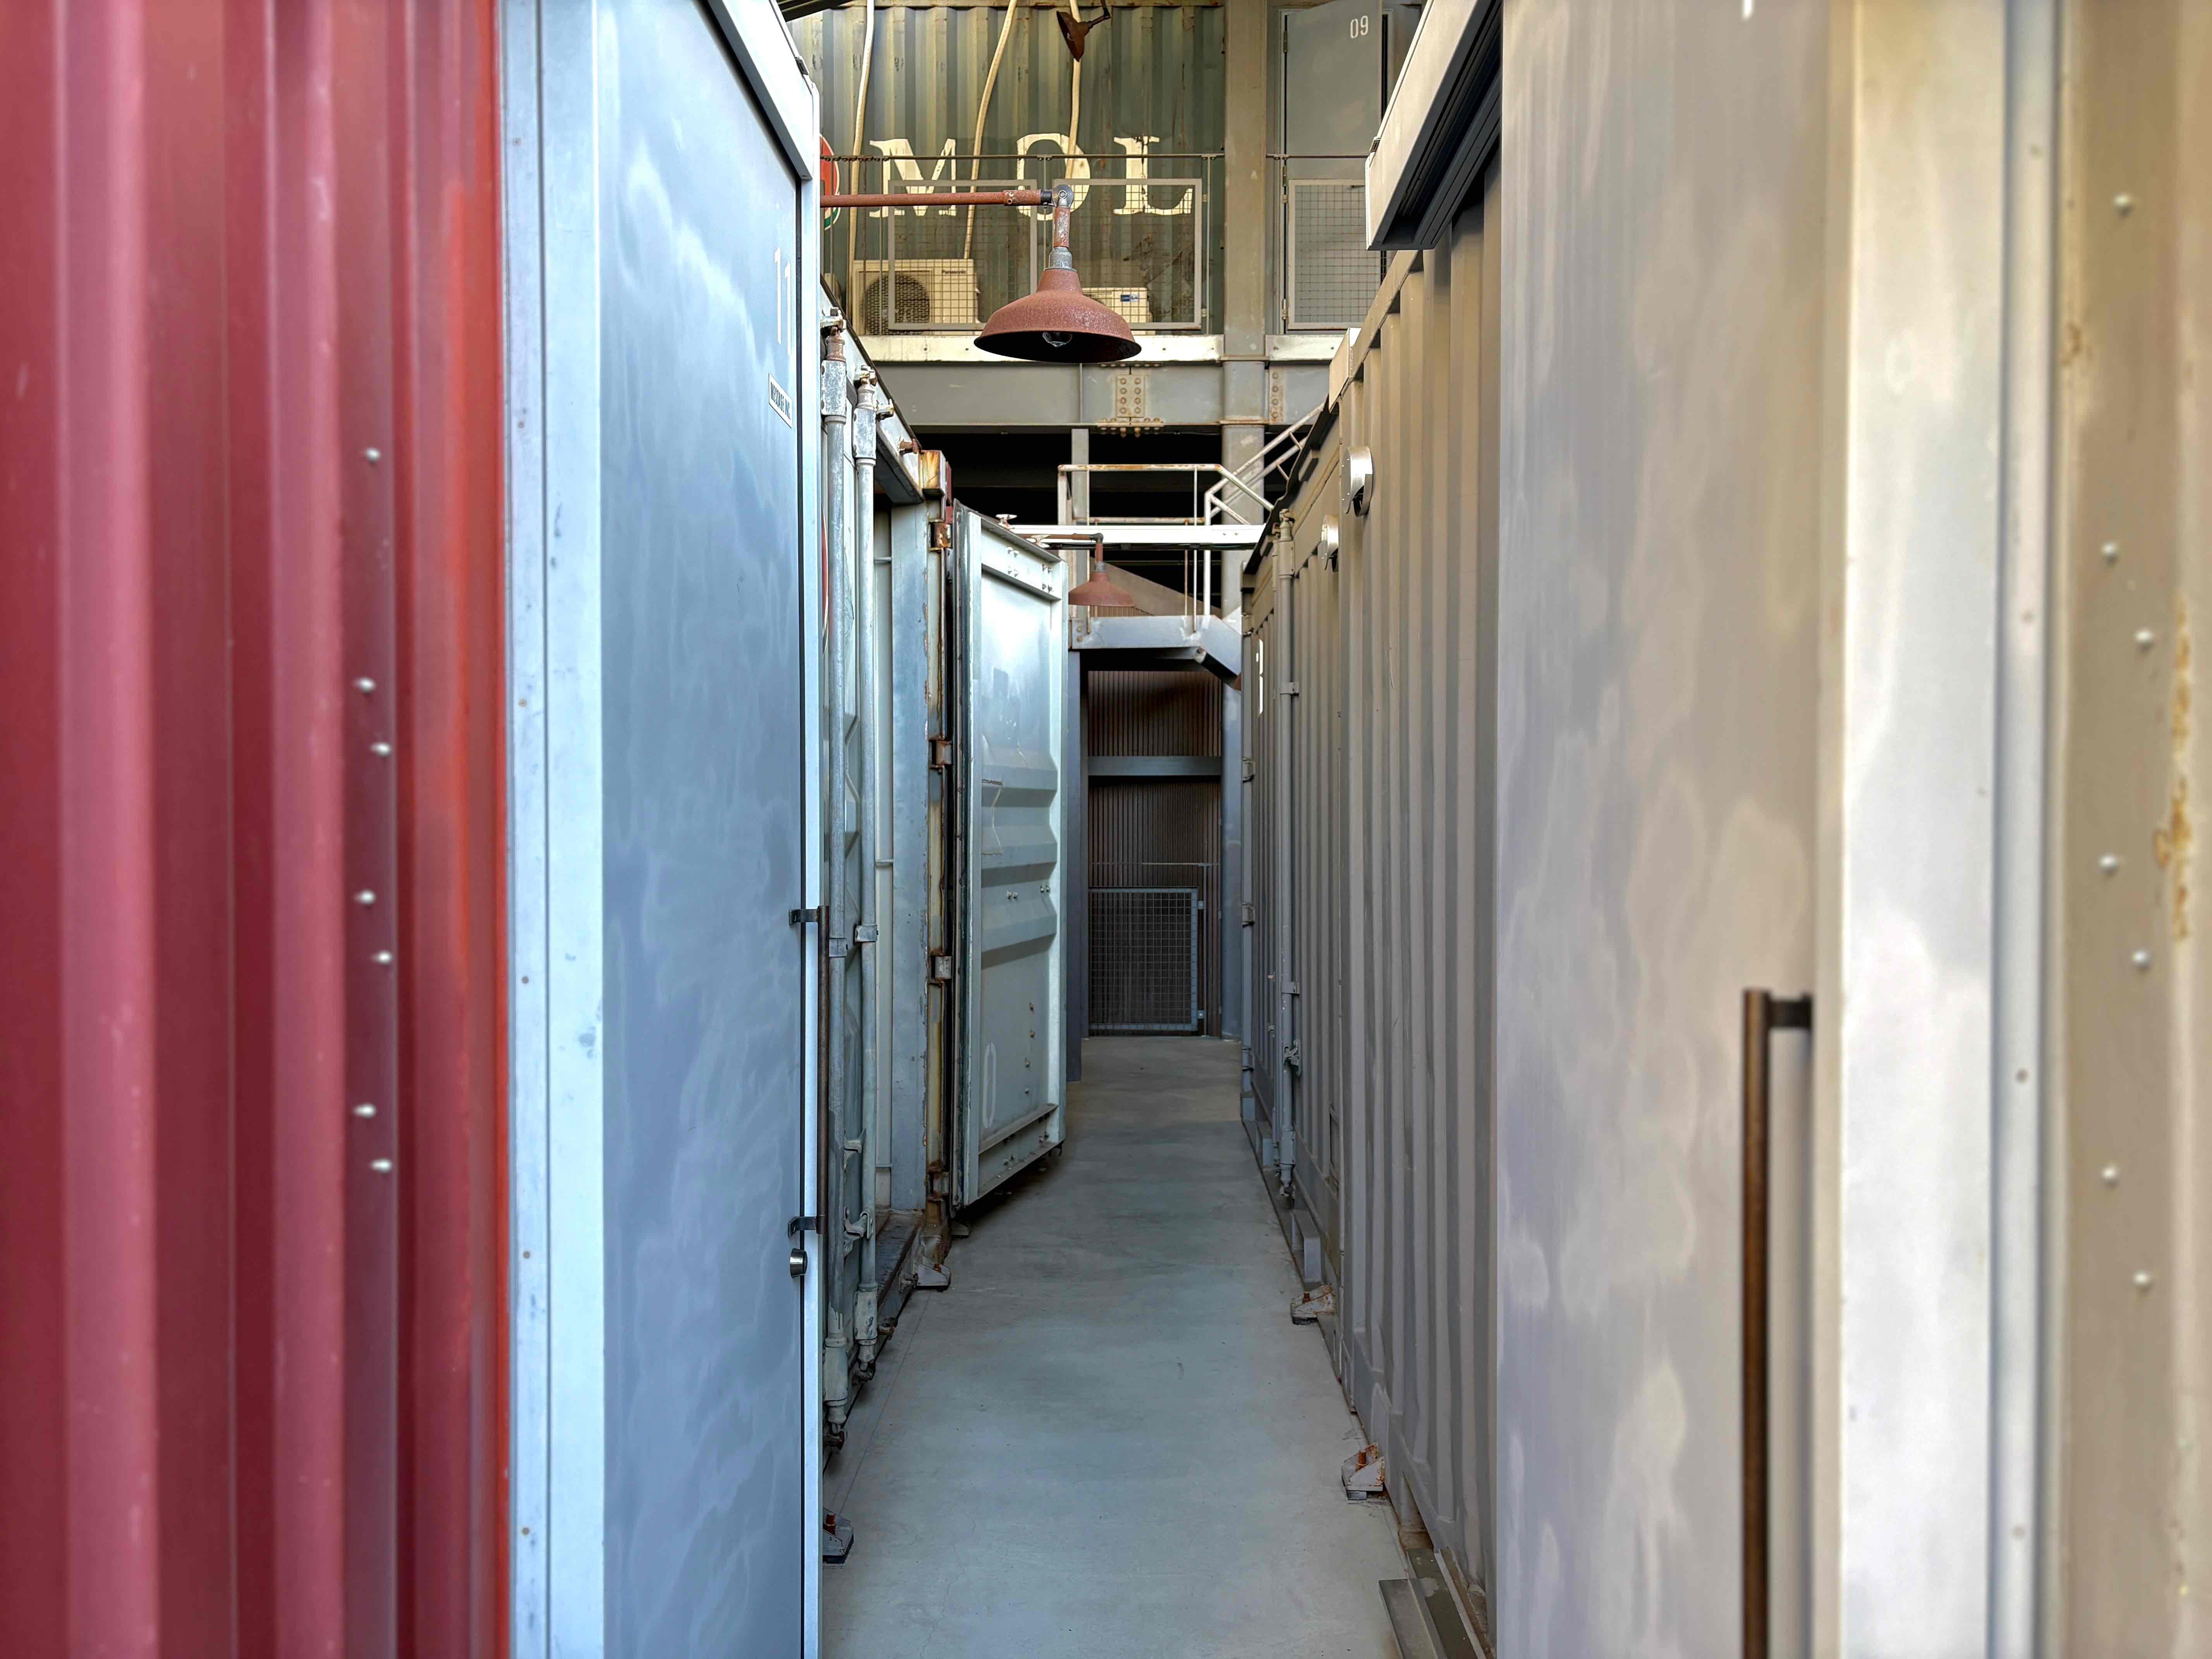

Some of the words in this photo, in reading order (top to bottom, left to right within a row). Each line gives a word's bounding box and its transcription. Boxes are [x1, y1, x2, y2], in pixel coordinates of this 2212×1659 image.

[1350, 15, 1369, 39] 09
[869, 133, 1193, 221] MOL
[775, 246, 791, 357] 11
[771, 381, 784, 413] MESSAGE
